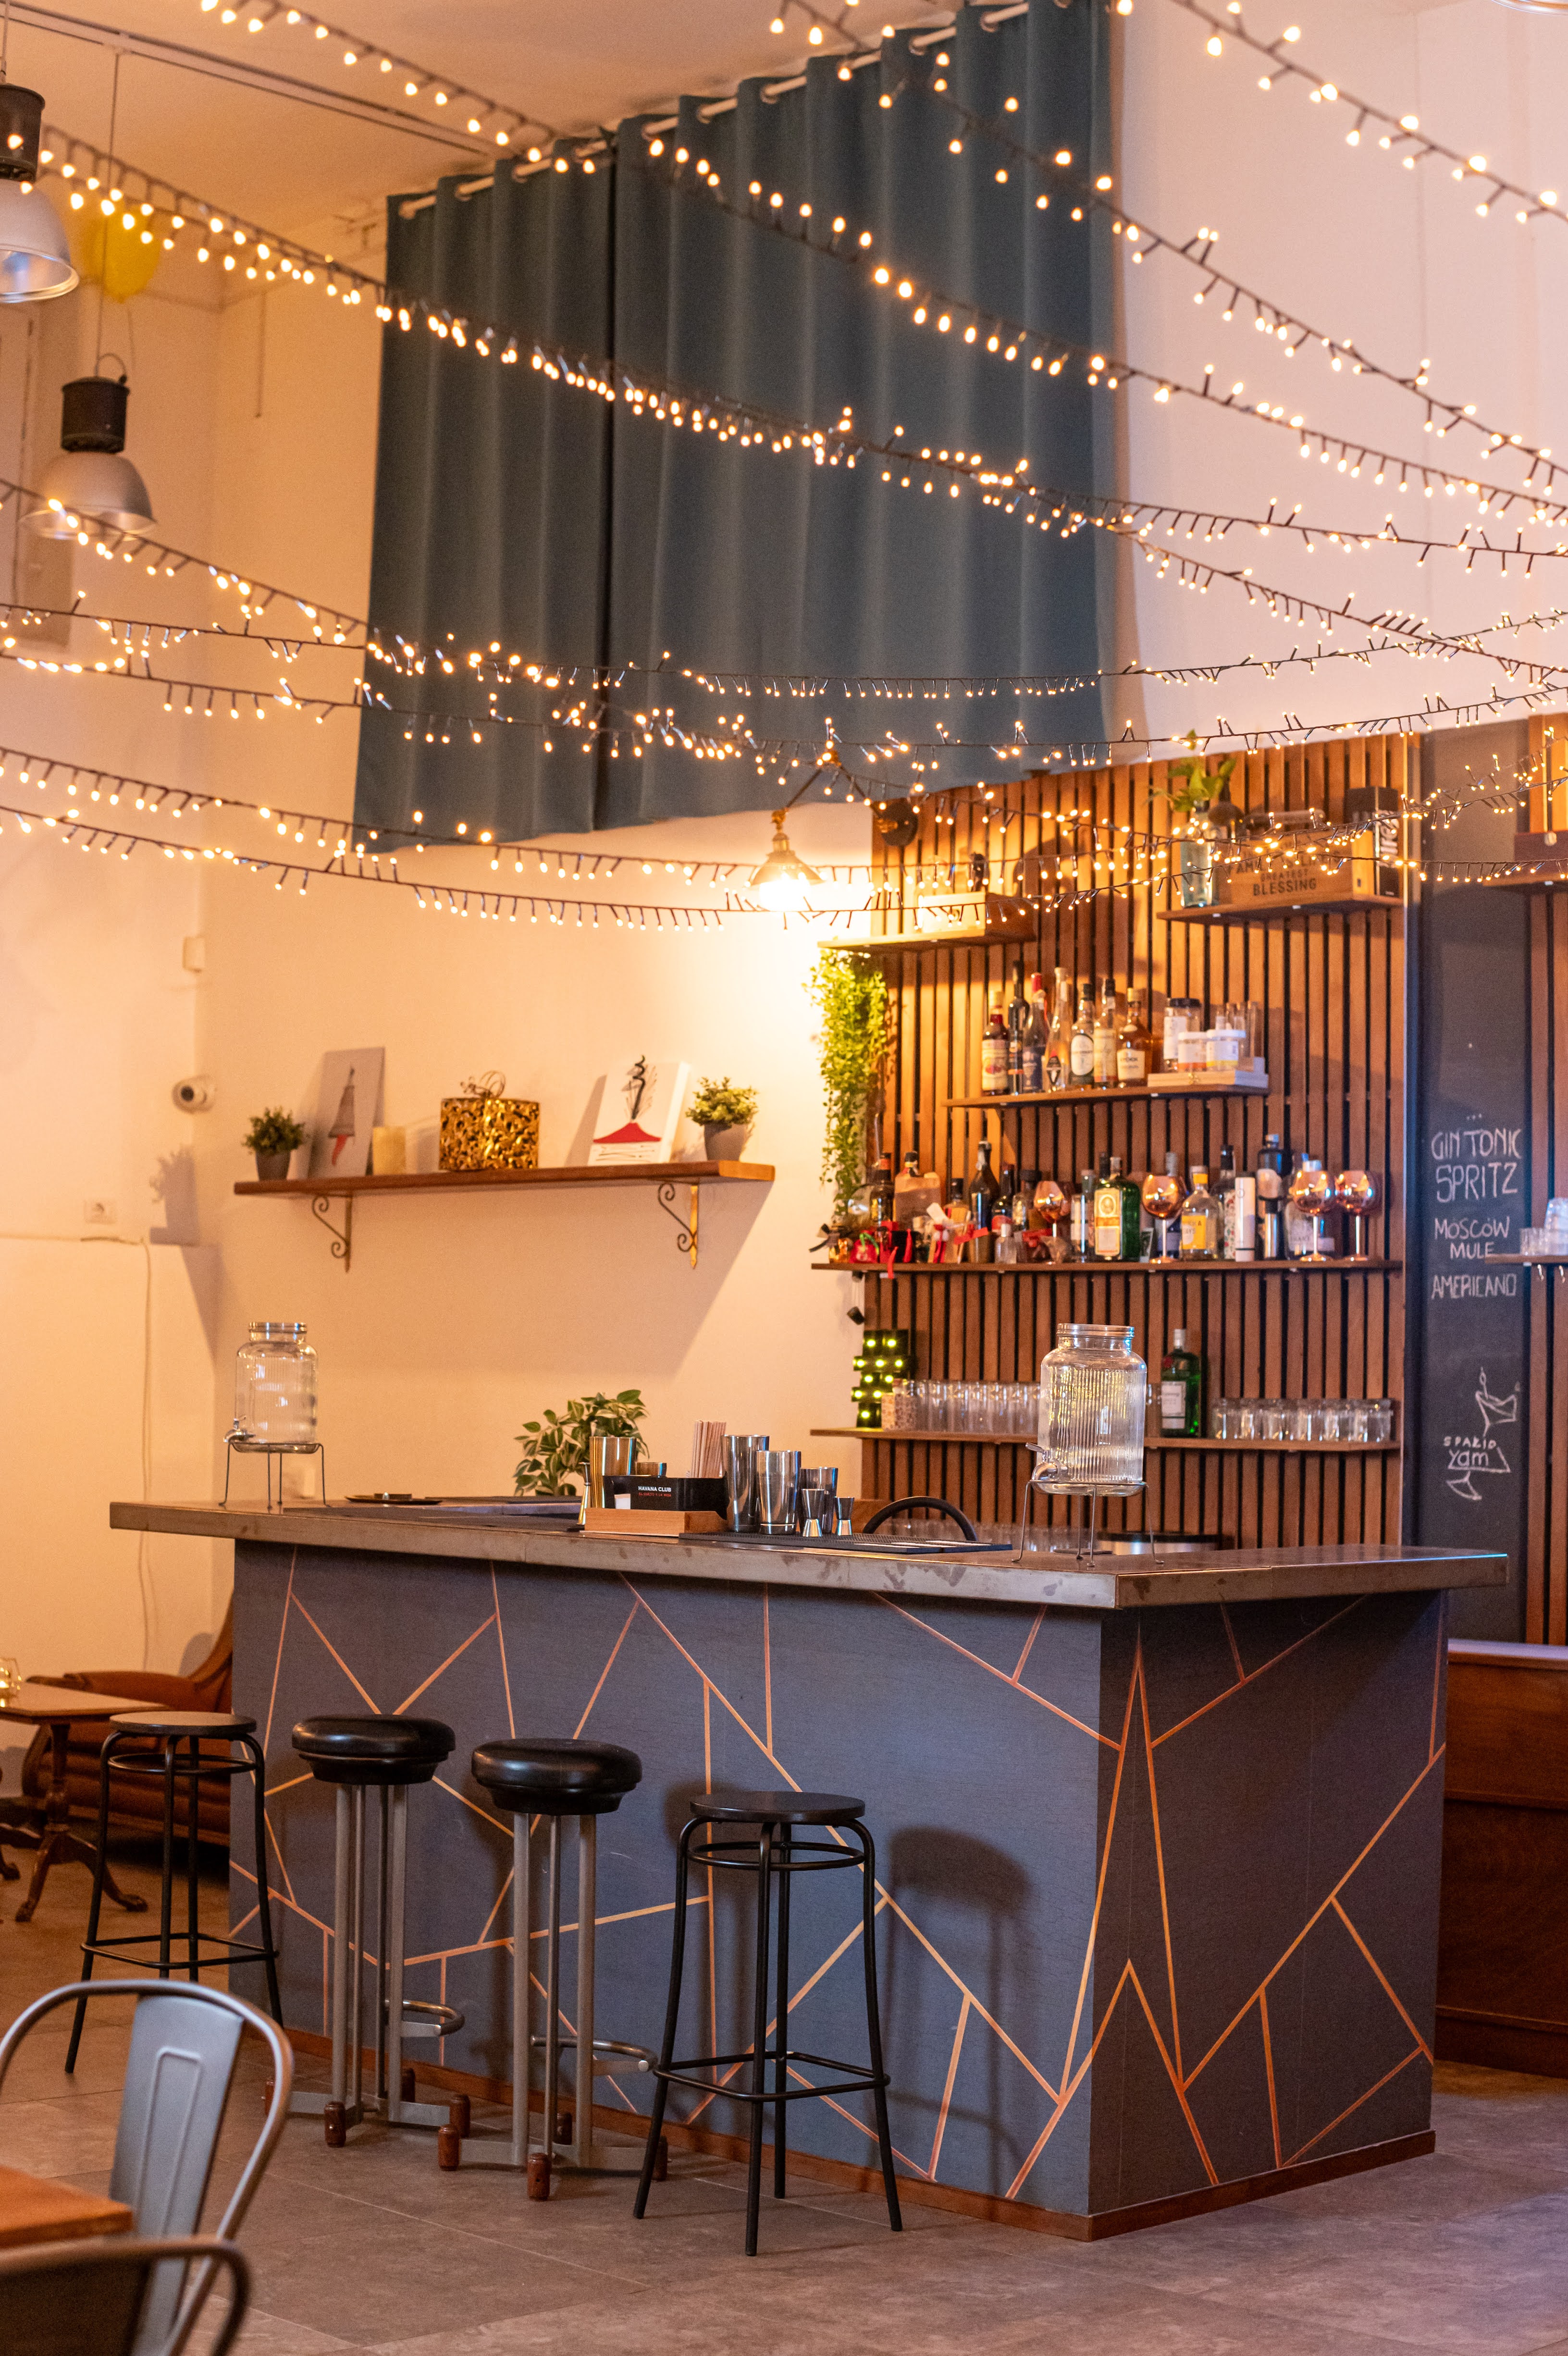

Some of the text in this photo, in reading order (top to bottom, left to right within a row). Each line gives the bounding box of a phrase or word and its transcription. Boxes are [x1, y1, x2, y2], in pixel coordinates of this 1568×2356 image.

[1253, 878, 1317, 897] BLESSING
[1431, 1128, 1521, 1159] GIN TONIC
[1436, 1162, 1518, 1202] SPRITZ
[1434, 1216, 1510, 1239] MOSCOW
[1450, 1242, 1494, 1259] MULE
[1432, 1273, 1517, 1299] AMERICANO
